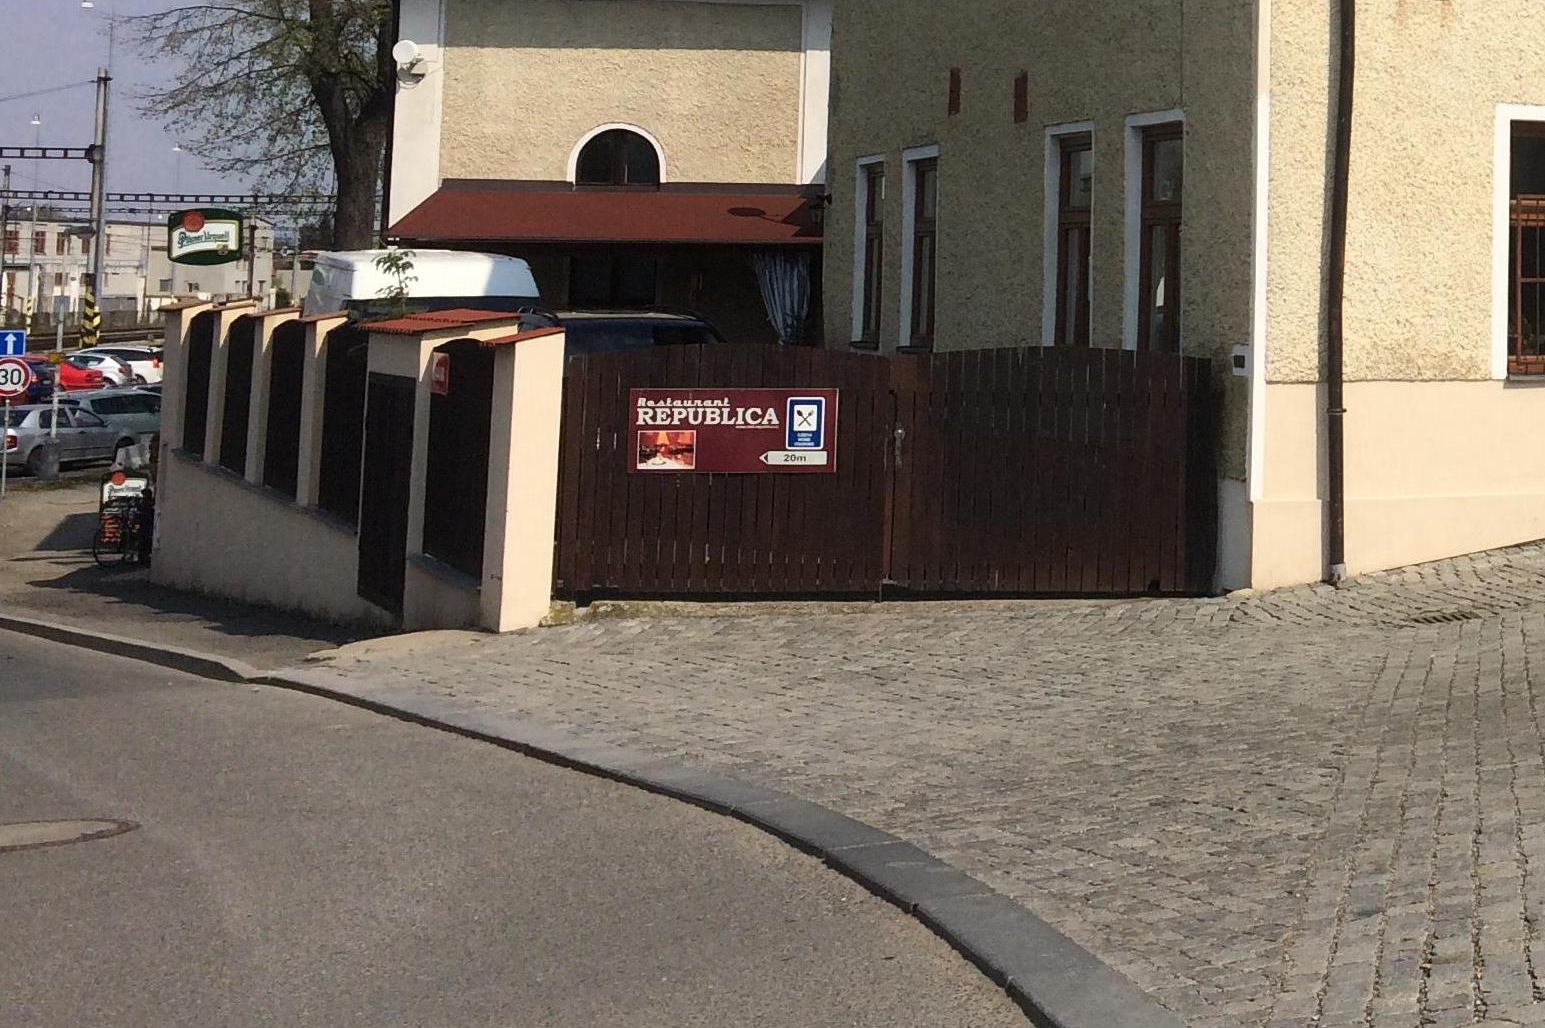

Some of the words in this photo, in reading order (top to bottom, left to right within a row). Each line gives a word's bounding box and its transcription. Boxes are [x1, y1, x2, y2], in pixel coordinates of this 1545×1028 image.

[0, 368, 22, 385] 30
[637, 397, 731, 407] Restaurant
[636, 407, 780, 425] REPUBLICA
[783, 454, 807, 462] 20m
